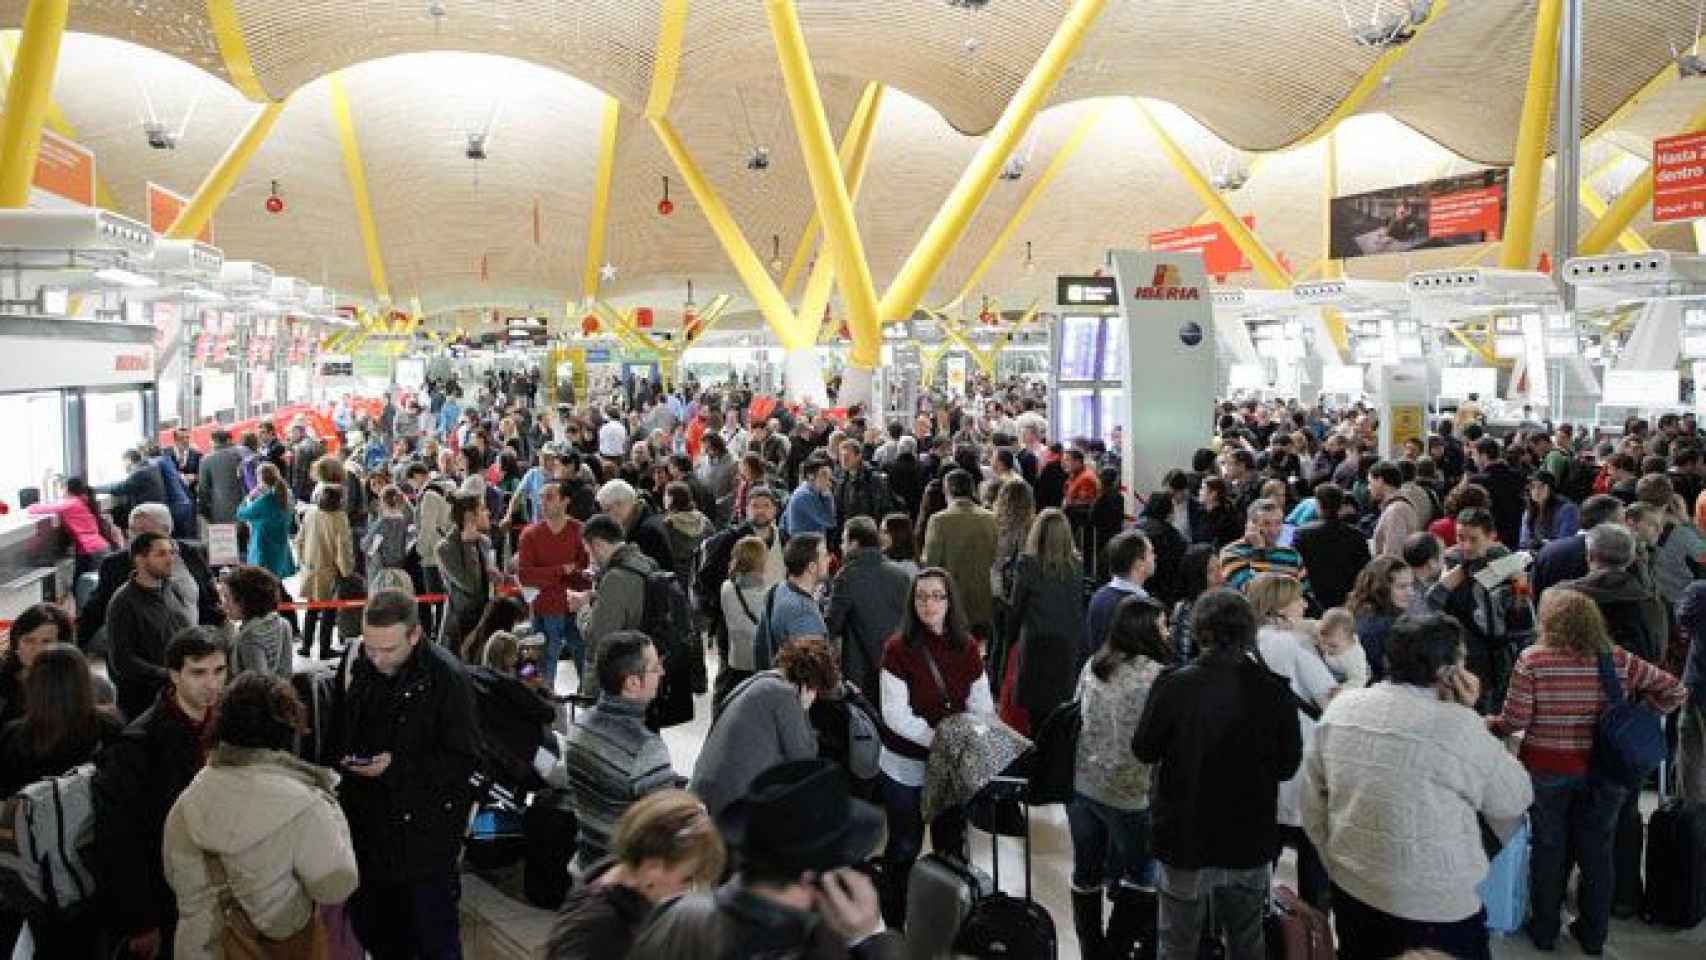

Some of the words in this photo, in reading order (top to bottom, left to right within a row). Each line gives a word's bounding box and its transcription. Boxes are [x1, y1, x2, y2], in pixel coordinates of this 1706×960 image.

[1657, 148, 1697, 167] Hasta
[1657, 165, 1704, 182] dentro
[1134, 287, 1199, 300] IBERIA
